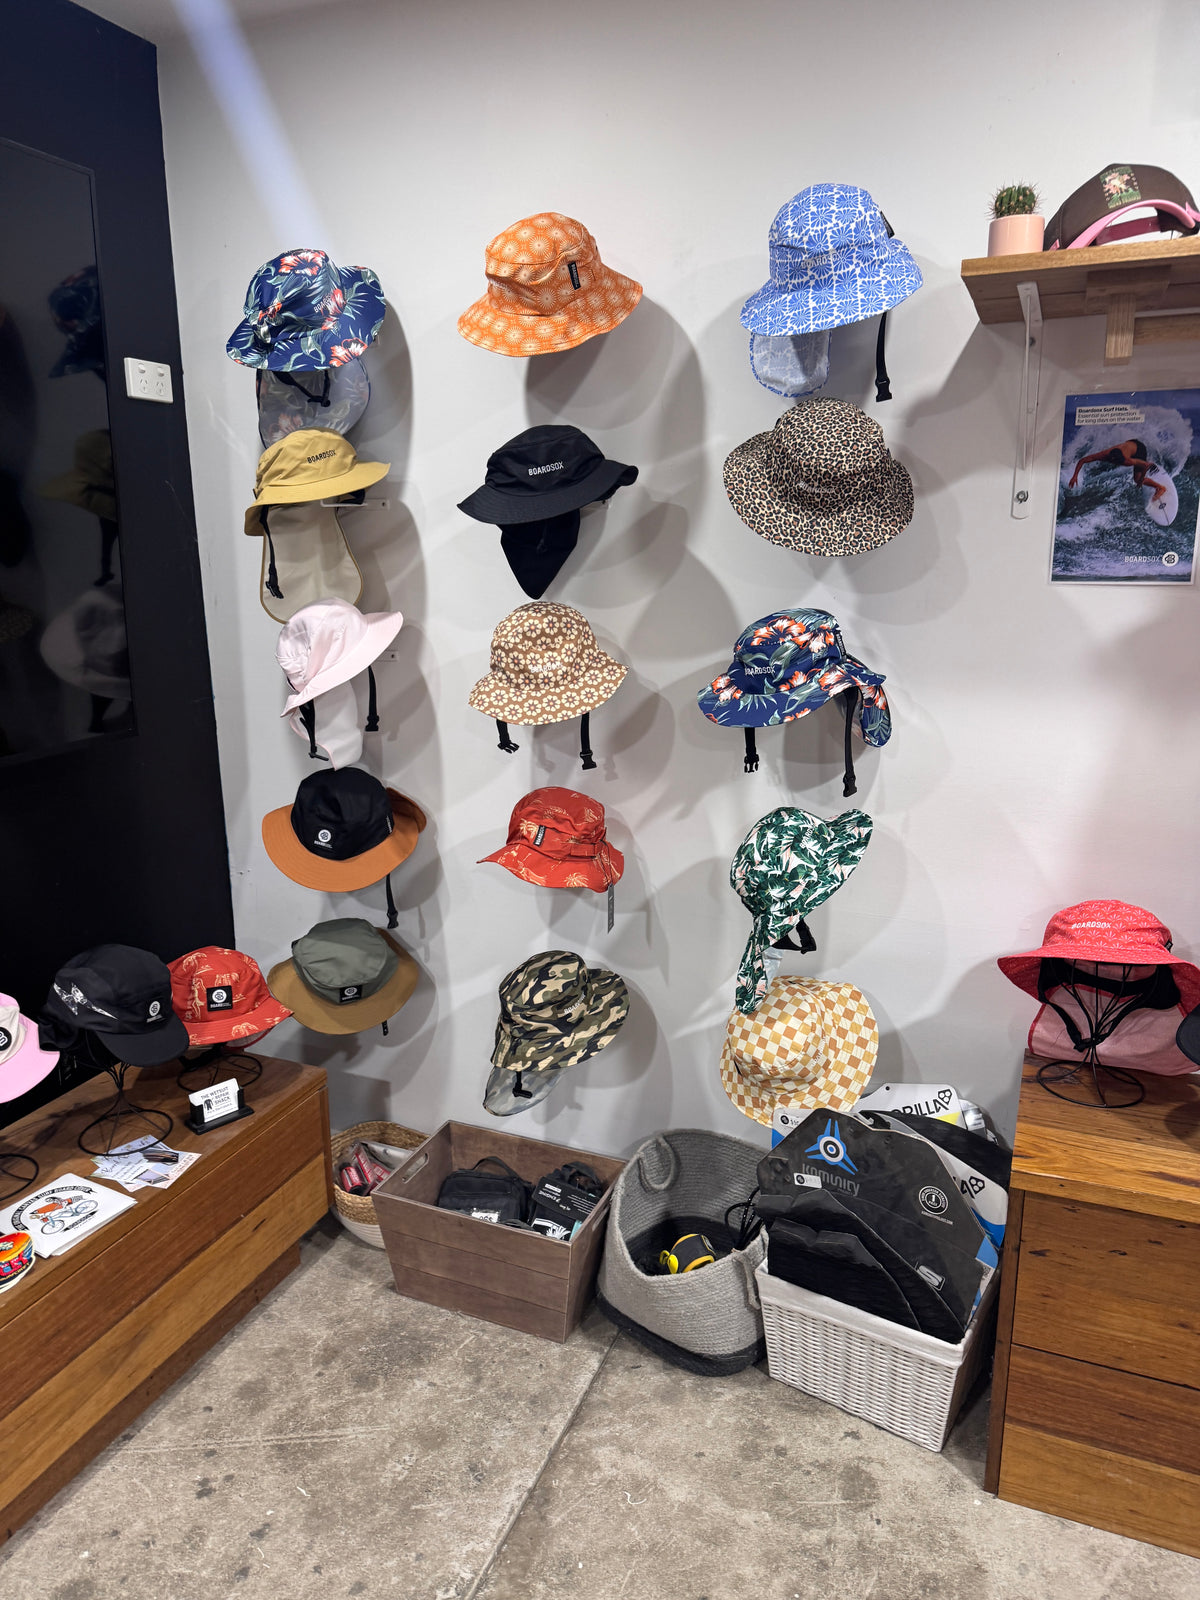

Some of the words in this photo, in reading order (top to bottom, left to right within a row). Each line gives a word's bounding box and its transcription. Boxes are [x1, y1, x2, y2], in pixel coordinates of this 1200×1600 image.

[306, 449, 336, 464] BOARDSOX
[528, 461, 564, 476] BOARDSOX
[1124, 555, 1160, 563] BOARDSOX
[1071, 920, 1112, 929] BOARDSOX
